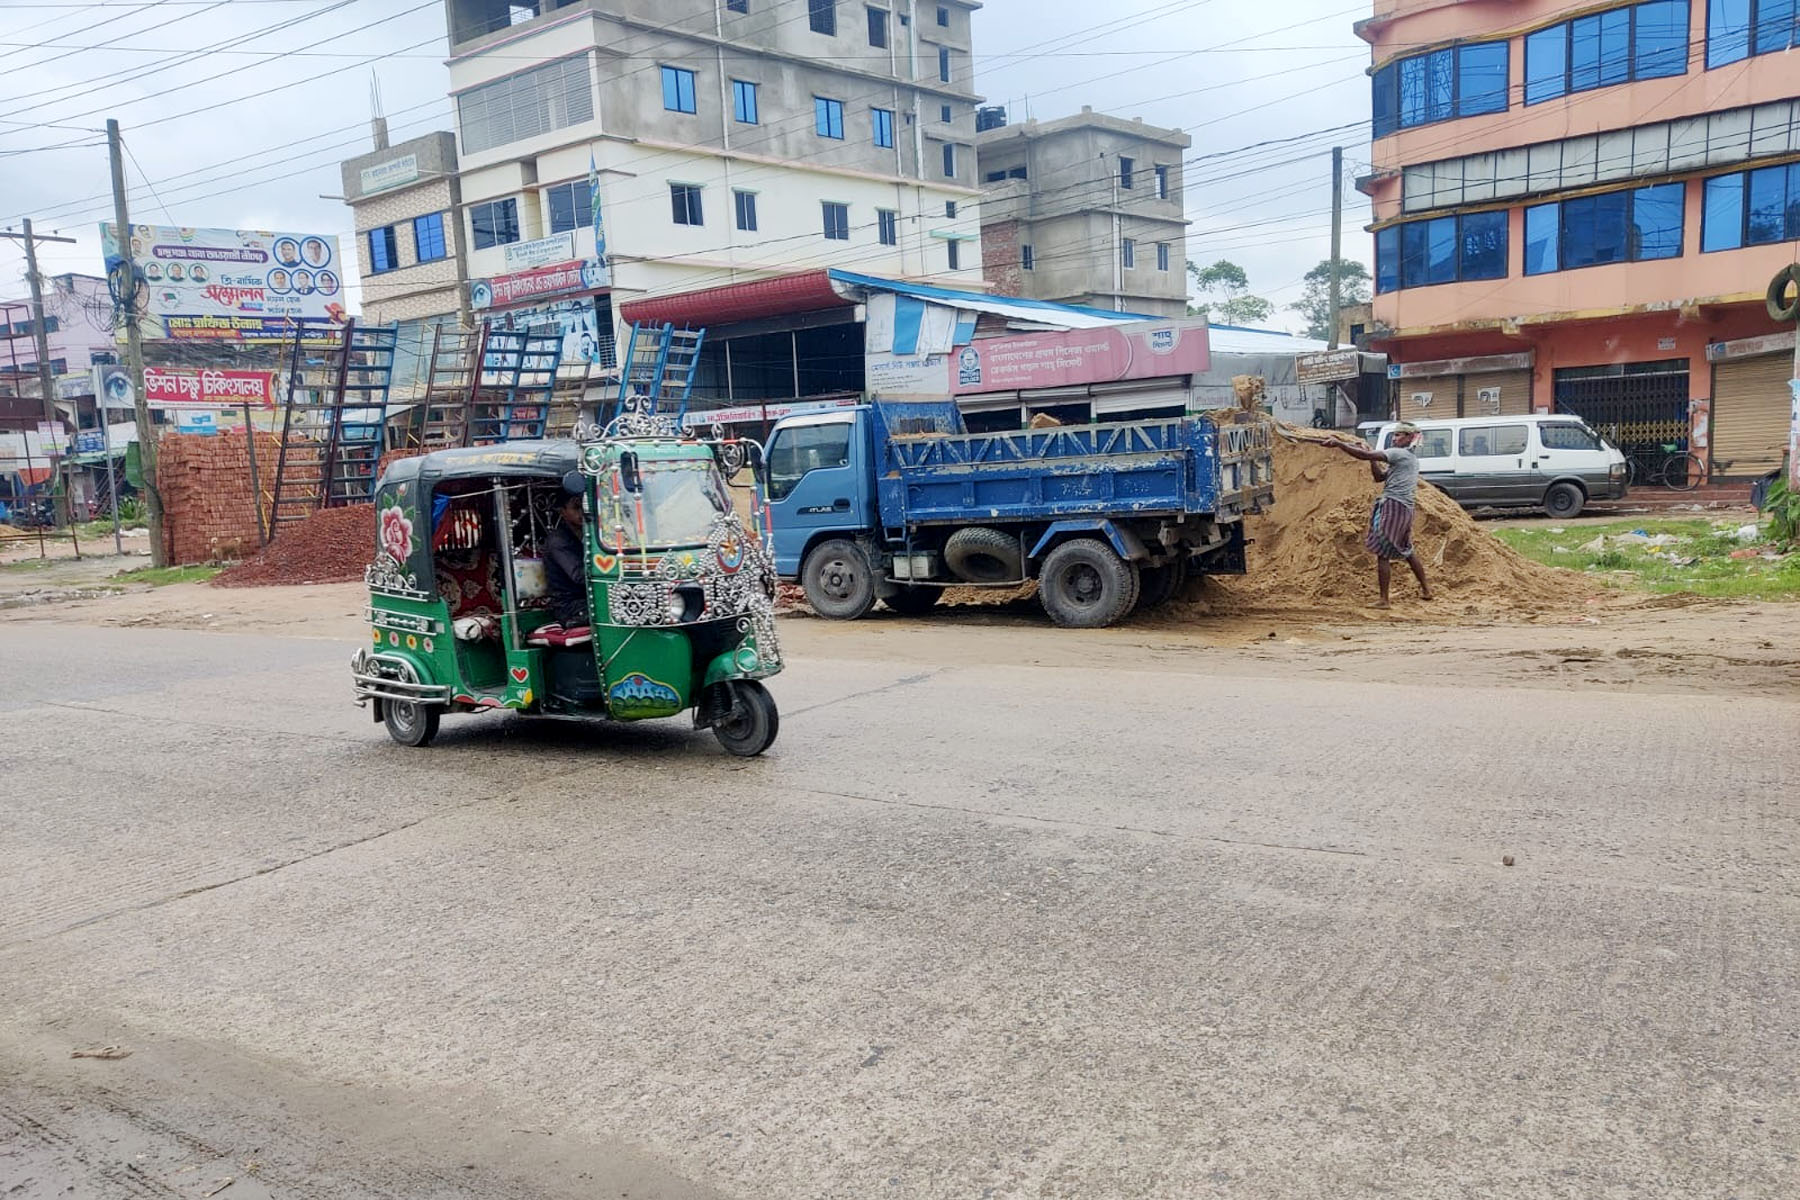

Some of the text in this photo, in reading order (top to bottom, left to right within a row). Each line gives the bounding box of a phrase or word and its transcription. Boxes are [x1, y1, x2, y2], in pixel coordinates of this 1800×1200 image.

[200, 284, 265, 306] সম্মেলন
[143, 368, 264, 400] ভিশন চক্ষু চিকিৎসালয়
